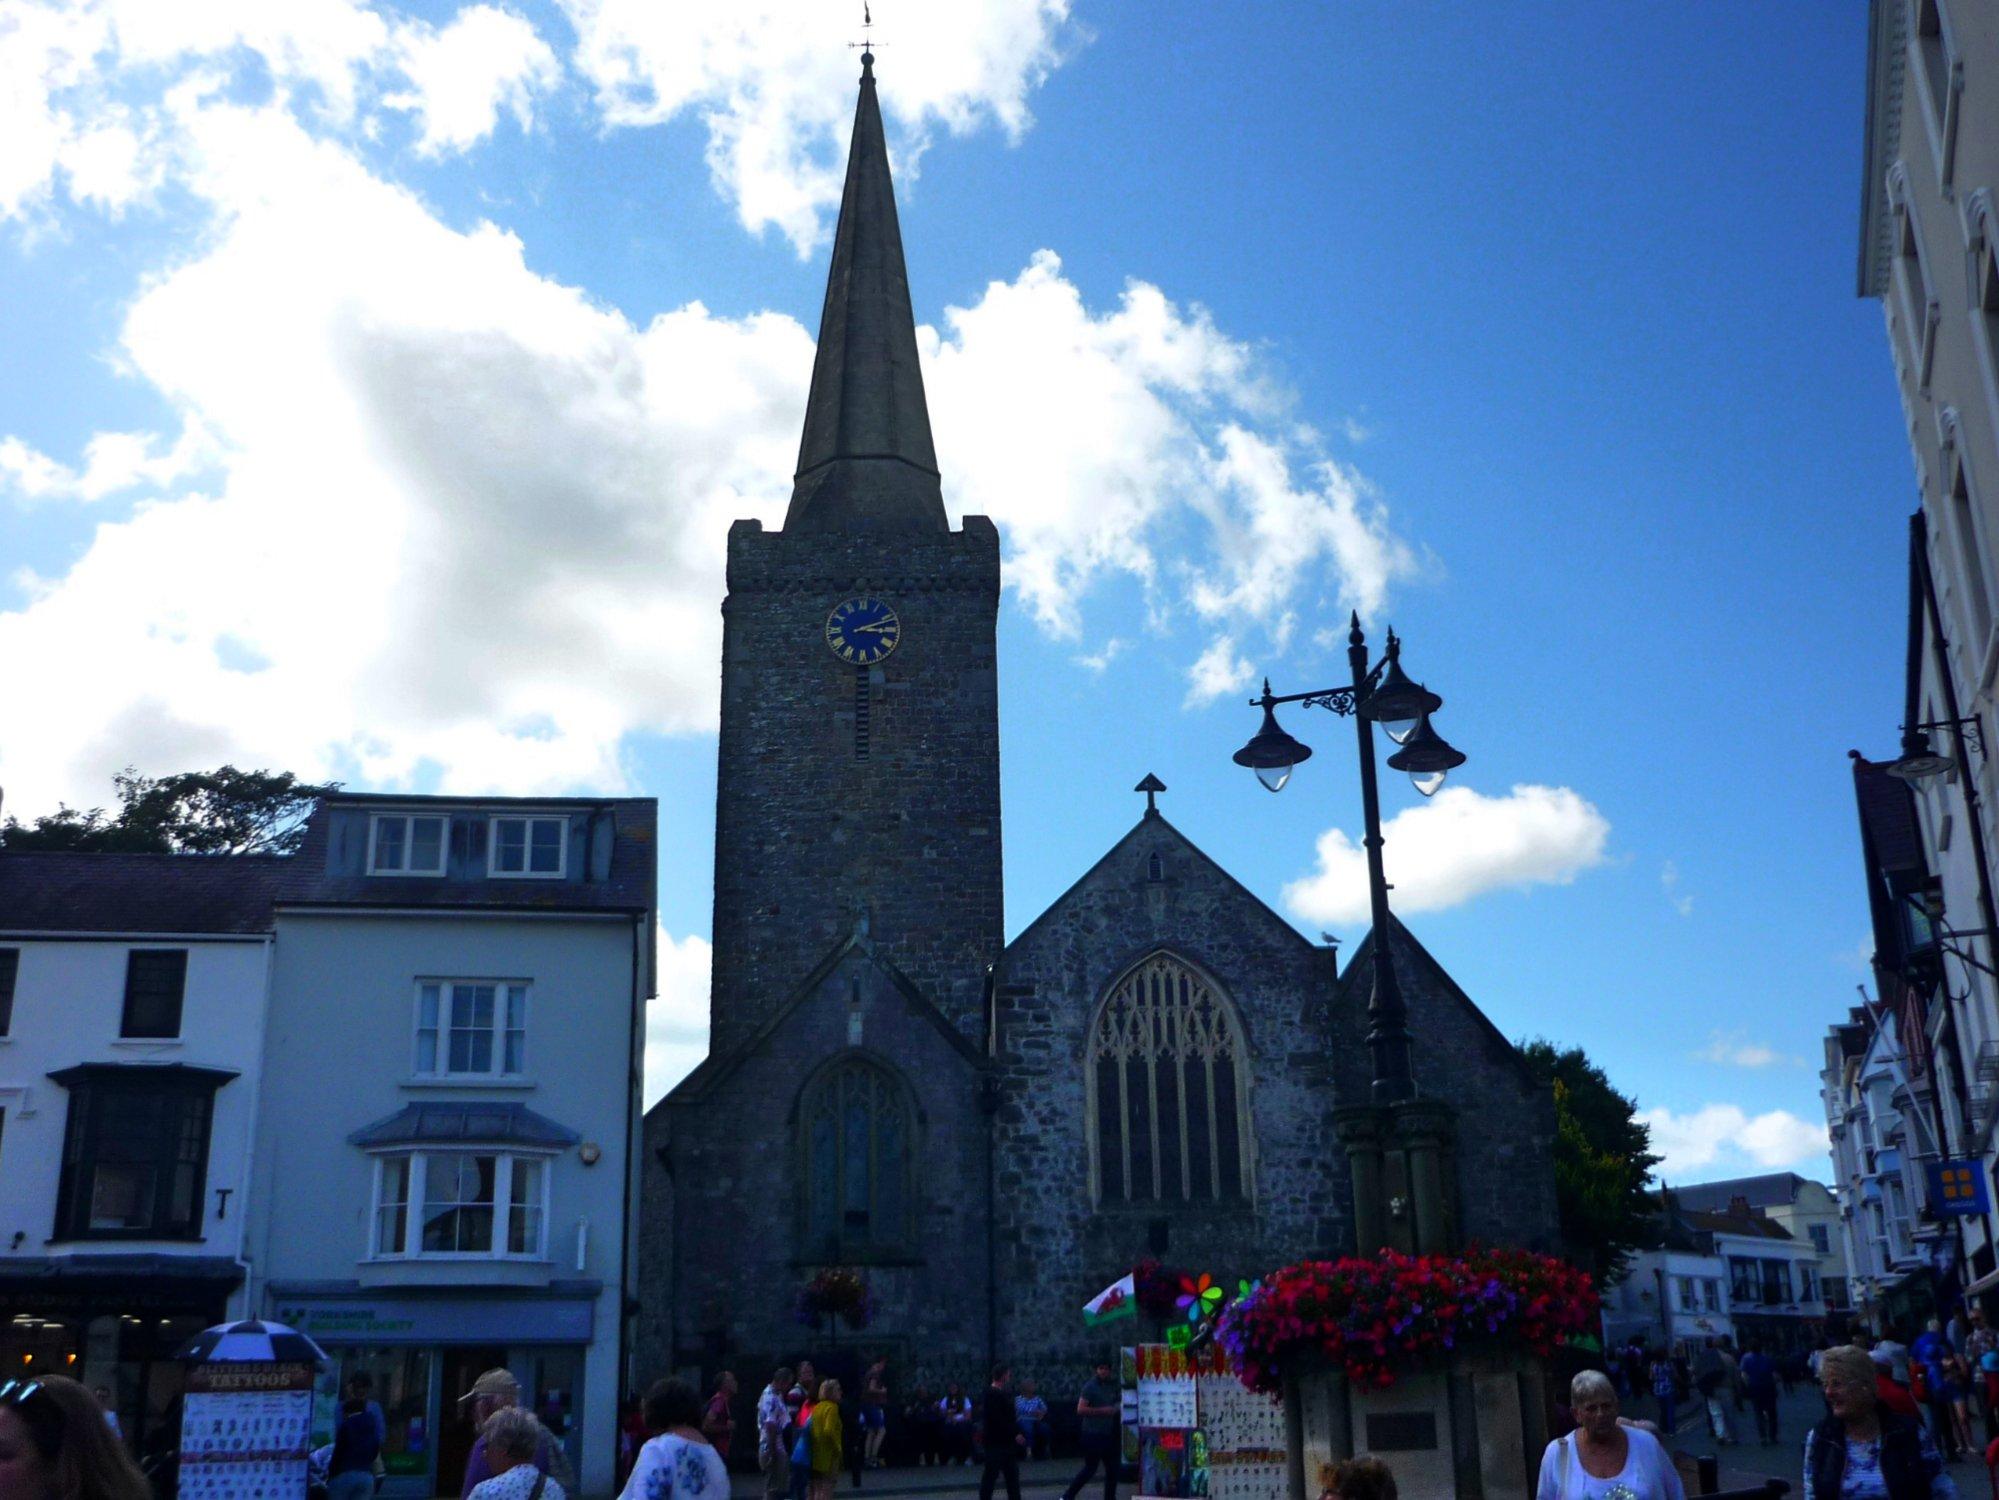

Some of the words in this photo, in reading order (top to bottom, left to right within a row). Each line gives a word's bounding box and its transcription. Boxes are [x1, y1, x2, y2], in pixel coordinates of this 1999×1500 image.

[310, 1310, 376, 1319] YORKSHIRE
[366, 1320, 415, 1330] SOCIETY
[208, 1372, 291, 1388] TATTOOS
